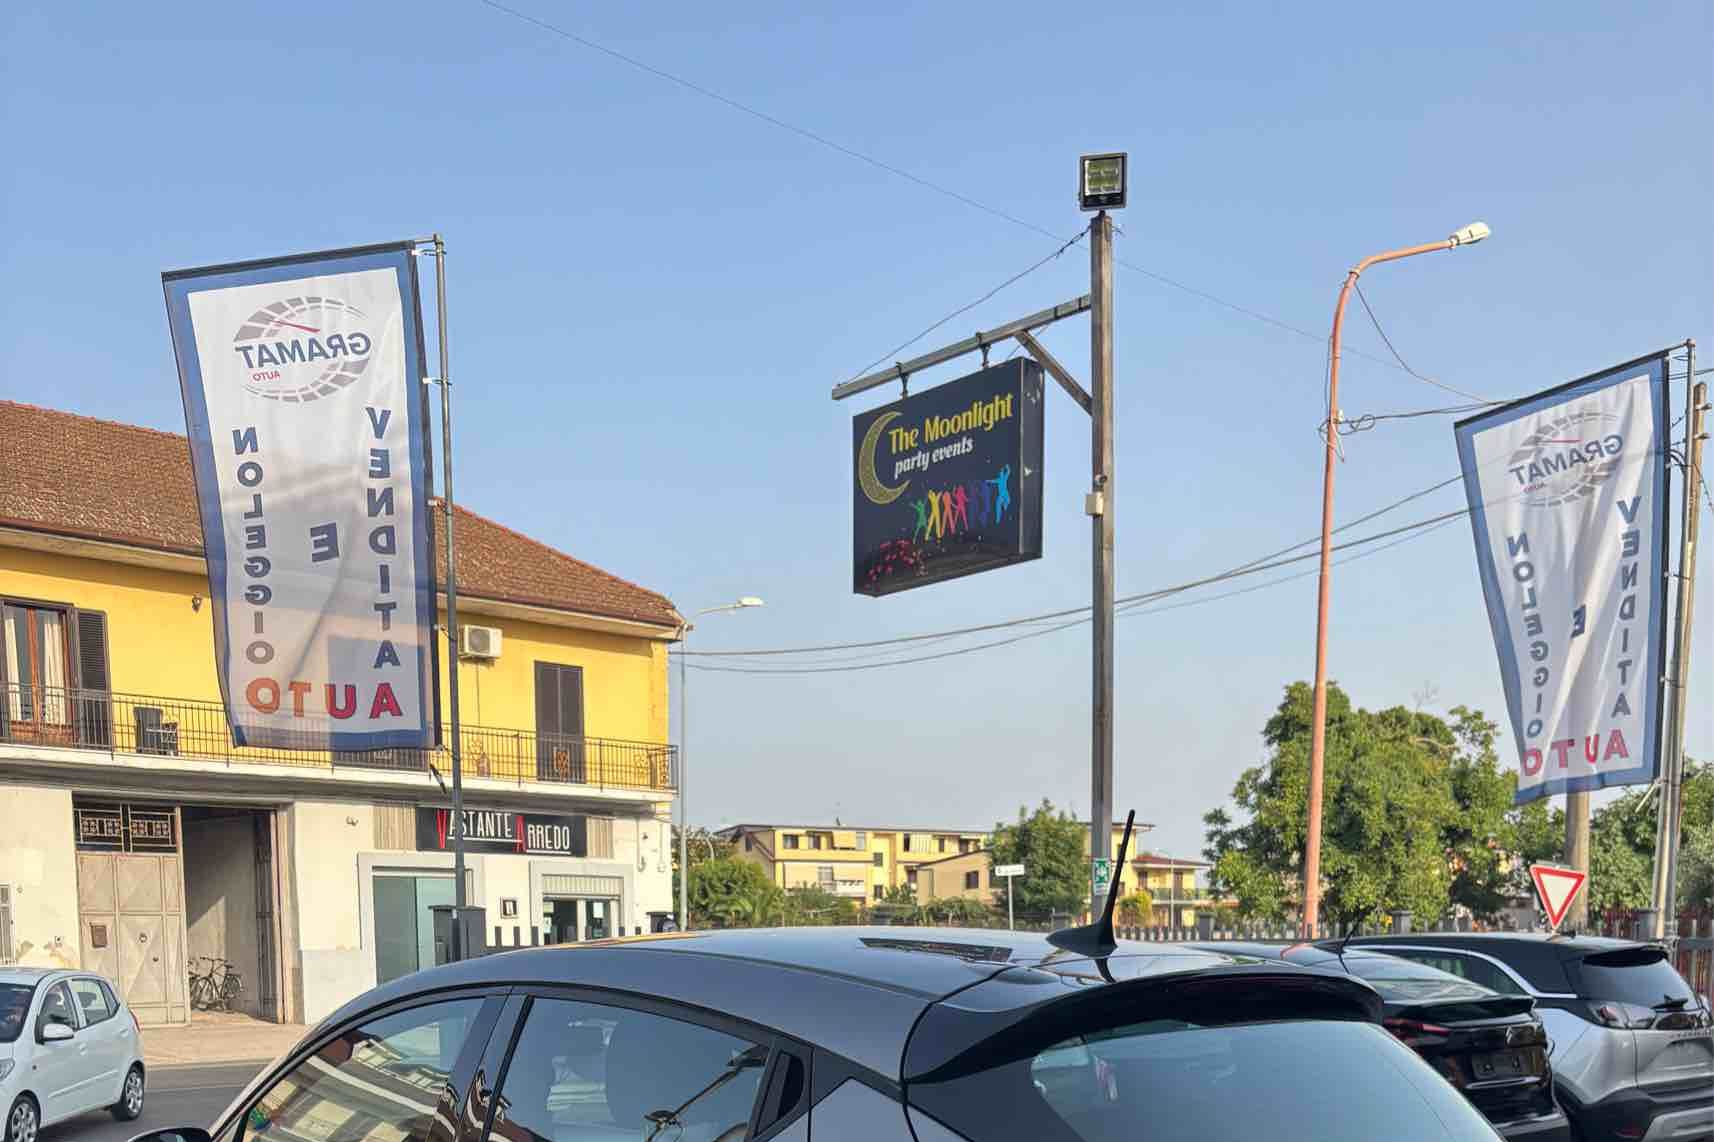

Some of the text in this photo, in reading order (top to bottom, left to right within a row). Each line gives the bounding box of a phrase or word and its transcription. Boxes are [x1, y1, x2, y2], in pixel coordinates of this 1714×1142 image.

[889, 393, 1013, 454] The Moonlight
[894, 436, 974, 480] party events
[513, 815, 571, 853] ARREDO
